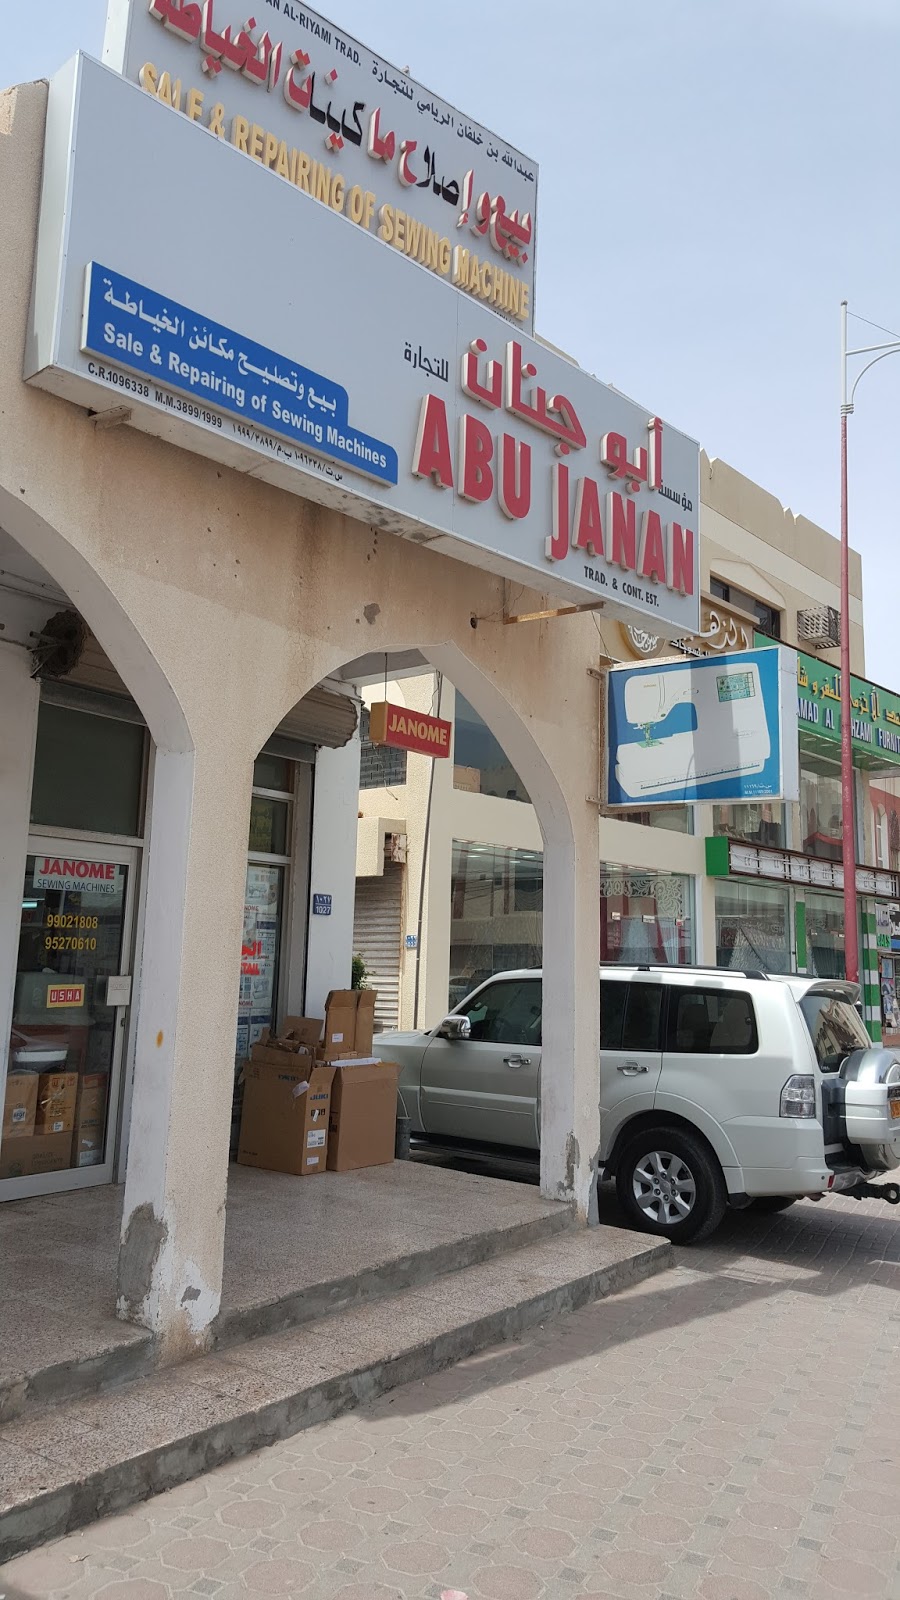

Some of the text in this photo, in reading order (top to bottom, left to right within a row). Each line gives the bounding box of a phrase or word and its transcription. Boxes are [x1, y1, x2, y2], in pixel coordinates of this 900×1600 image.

[283, 2, 332, 45] AL-RIYAMI
[334, 36, 362, 67] TRAD.
[371, 60, 414, 100] للتجارة
[416, 99, 454, 128] الريامي
[456, 123, 484, 145] خلفان
[486, 142, 499, 162] بن
[208, 101, 226, 141] &
[230, 113, 347, 215] REPAIRING
[348, 183, 377, 230] OF
[378, 202, 451, 278] SEWING
[452, 243, 530, 322] MACHINE
[102, 277, 338, 418] بيع وتصليح مكائن الخياطة
[403, 341, 449, 383] للتجارة
[87, 361, 223, 429] C.R.1096338 M.M.3899/1999
[103, 321, 388, 469] Sale & Repairing of Sewing Machines
[600, 416, 664, 495] أبو
[411, 392, 695, 597] ABU JANAN
[583, 565, 661, 608] TRAD. & CONT. EST.
[388, 714, 448, 746] JANOME
[825, 707, 836, 730] AL
[39, 858, 116, 880] JANOME
[37, 878, 115, 894] SEWING MACHINES
[46, 913, 99, 930] 99021808
[315, 905, 331, 914] 1027
[44, 936, 97, 951] 95270610
[51, 988, 81, 1002] USHA
